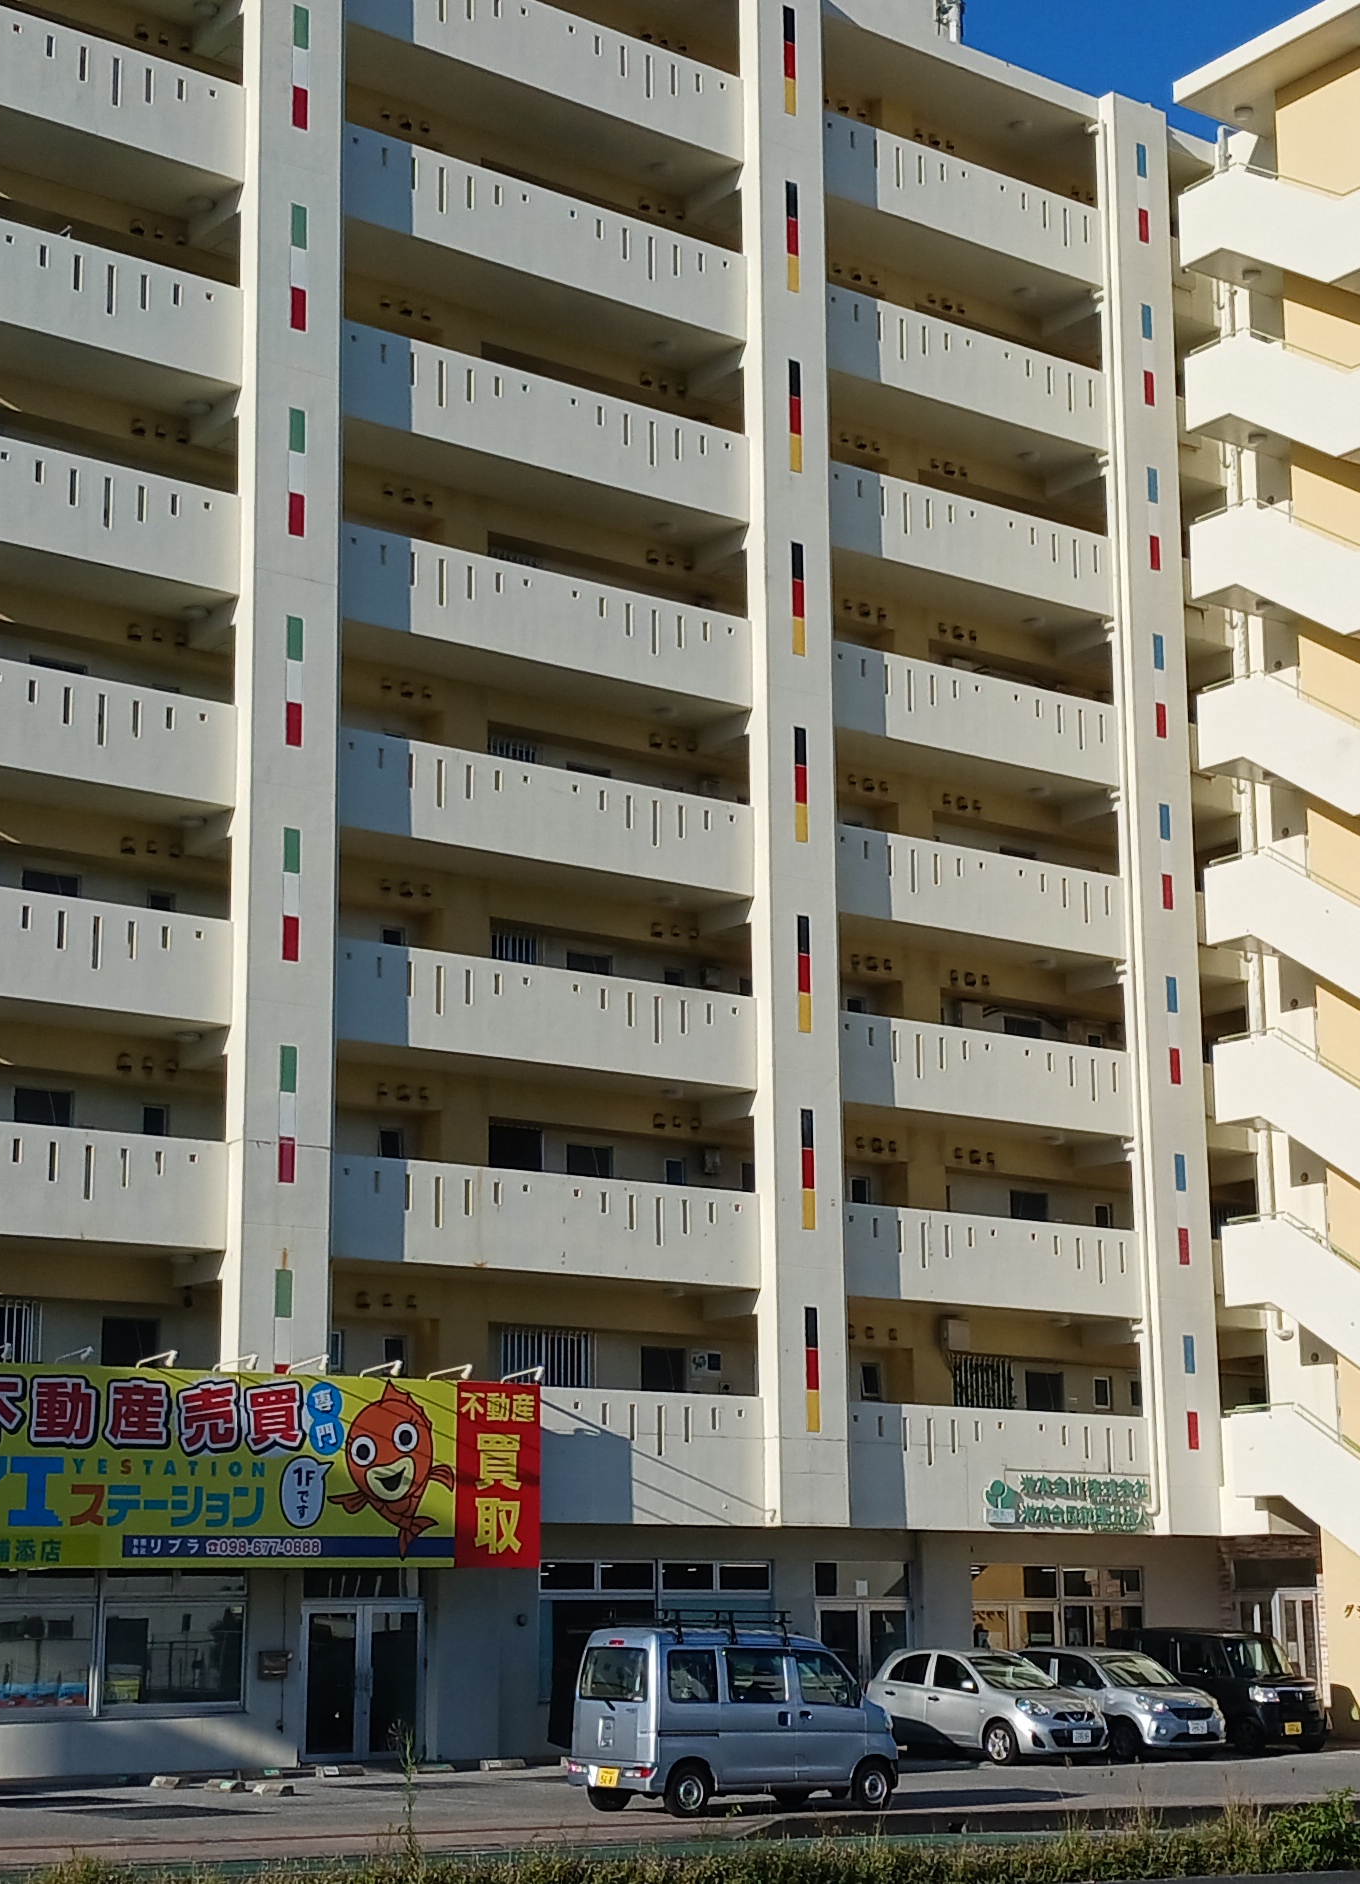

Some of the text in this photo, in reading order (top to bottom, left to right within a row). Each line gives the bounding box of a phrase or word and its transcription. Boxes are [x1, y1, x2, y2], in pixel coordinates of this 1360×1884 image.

[312, 1388, 337, 1448] 専門
[460, 1392, 535, 1422] 不動産
[73, 1457, 265, 1477] YESTATION
[474, 1433, 522, 1554] 買取
